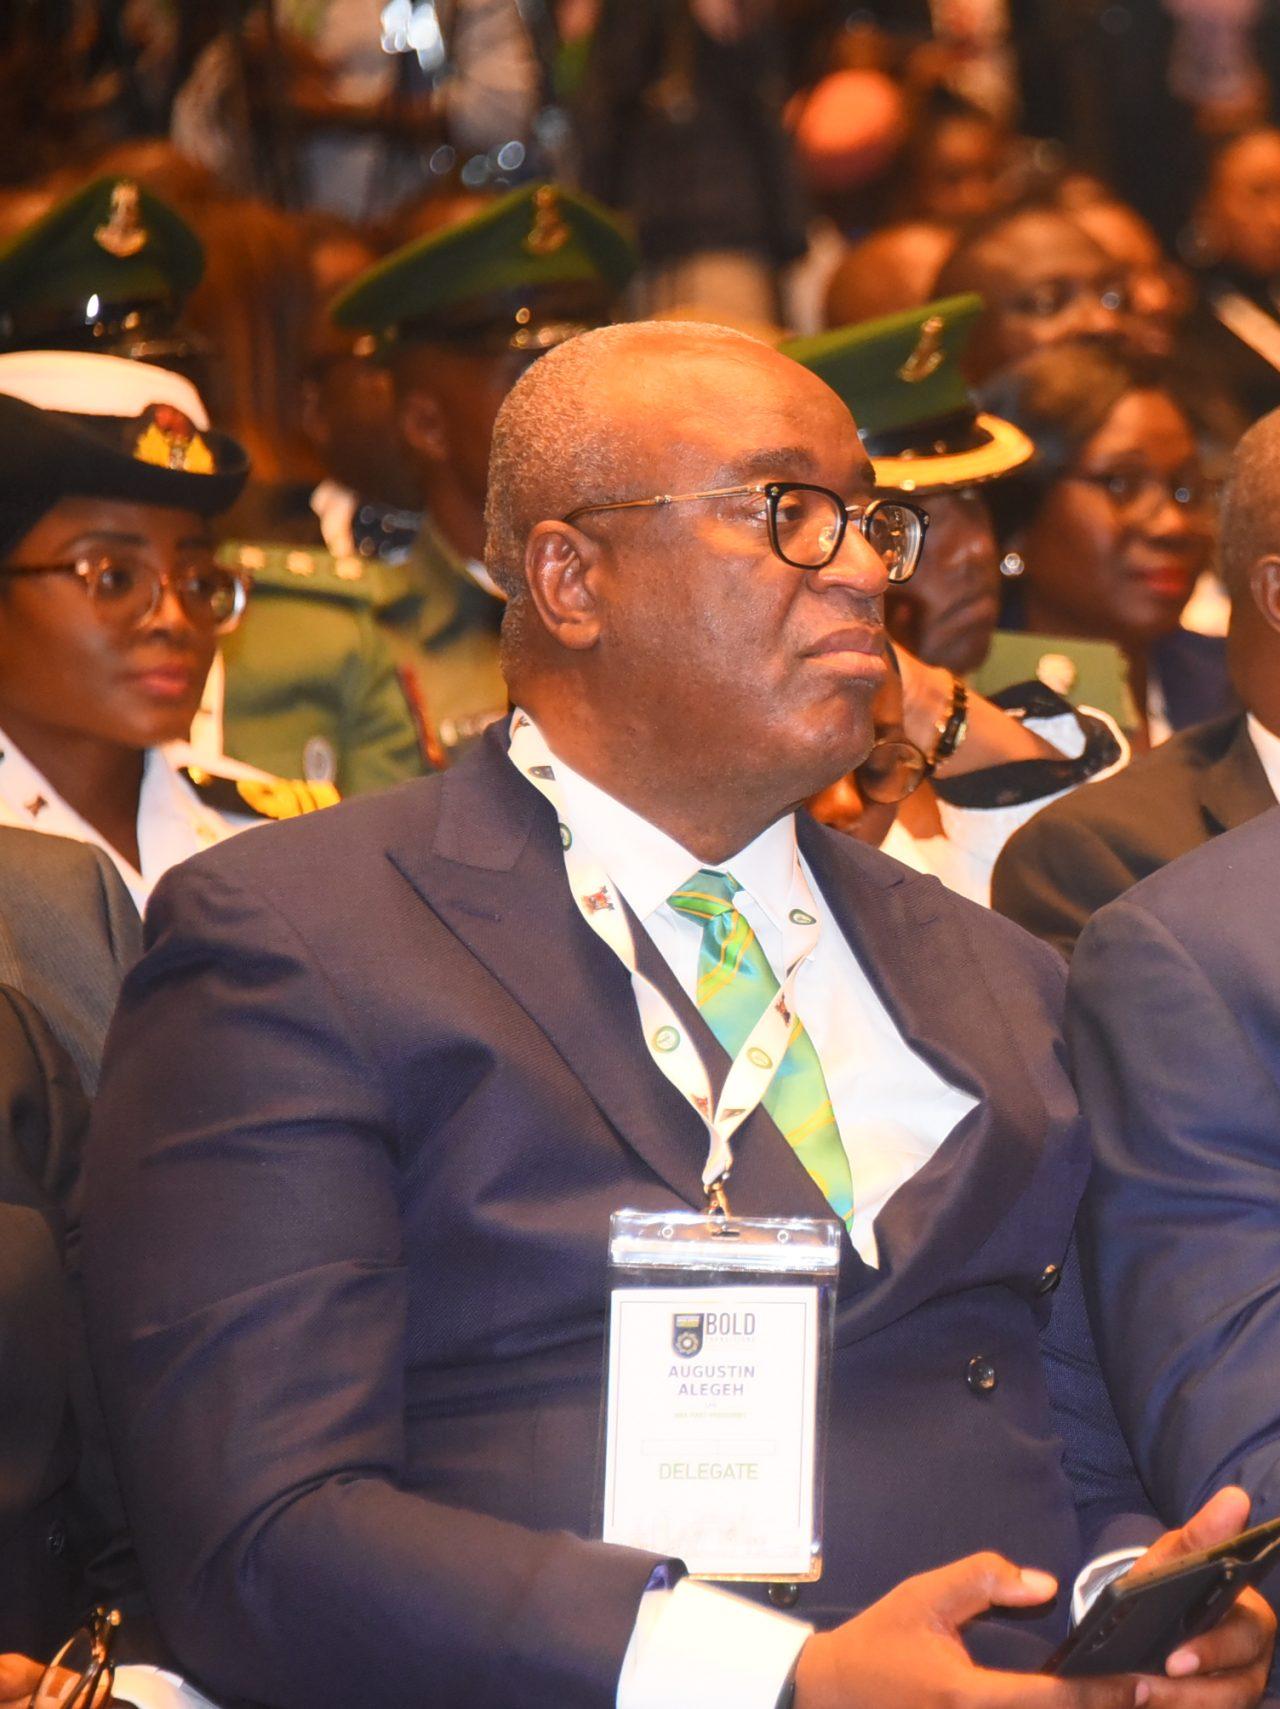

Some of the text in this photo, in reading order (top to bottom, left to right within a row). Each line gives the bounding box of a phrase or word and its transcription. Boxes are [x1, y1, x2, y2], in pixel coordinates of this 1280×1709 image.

[706, 1312, 756, 1335] BOLD
[668, 1365, 755, 1378] AUGUSTIN
[678, 1383, 744, 1396] ALEGEH
[658, 1462, 759, 1480] DELEGATE
